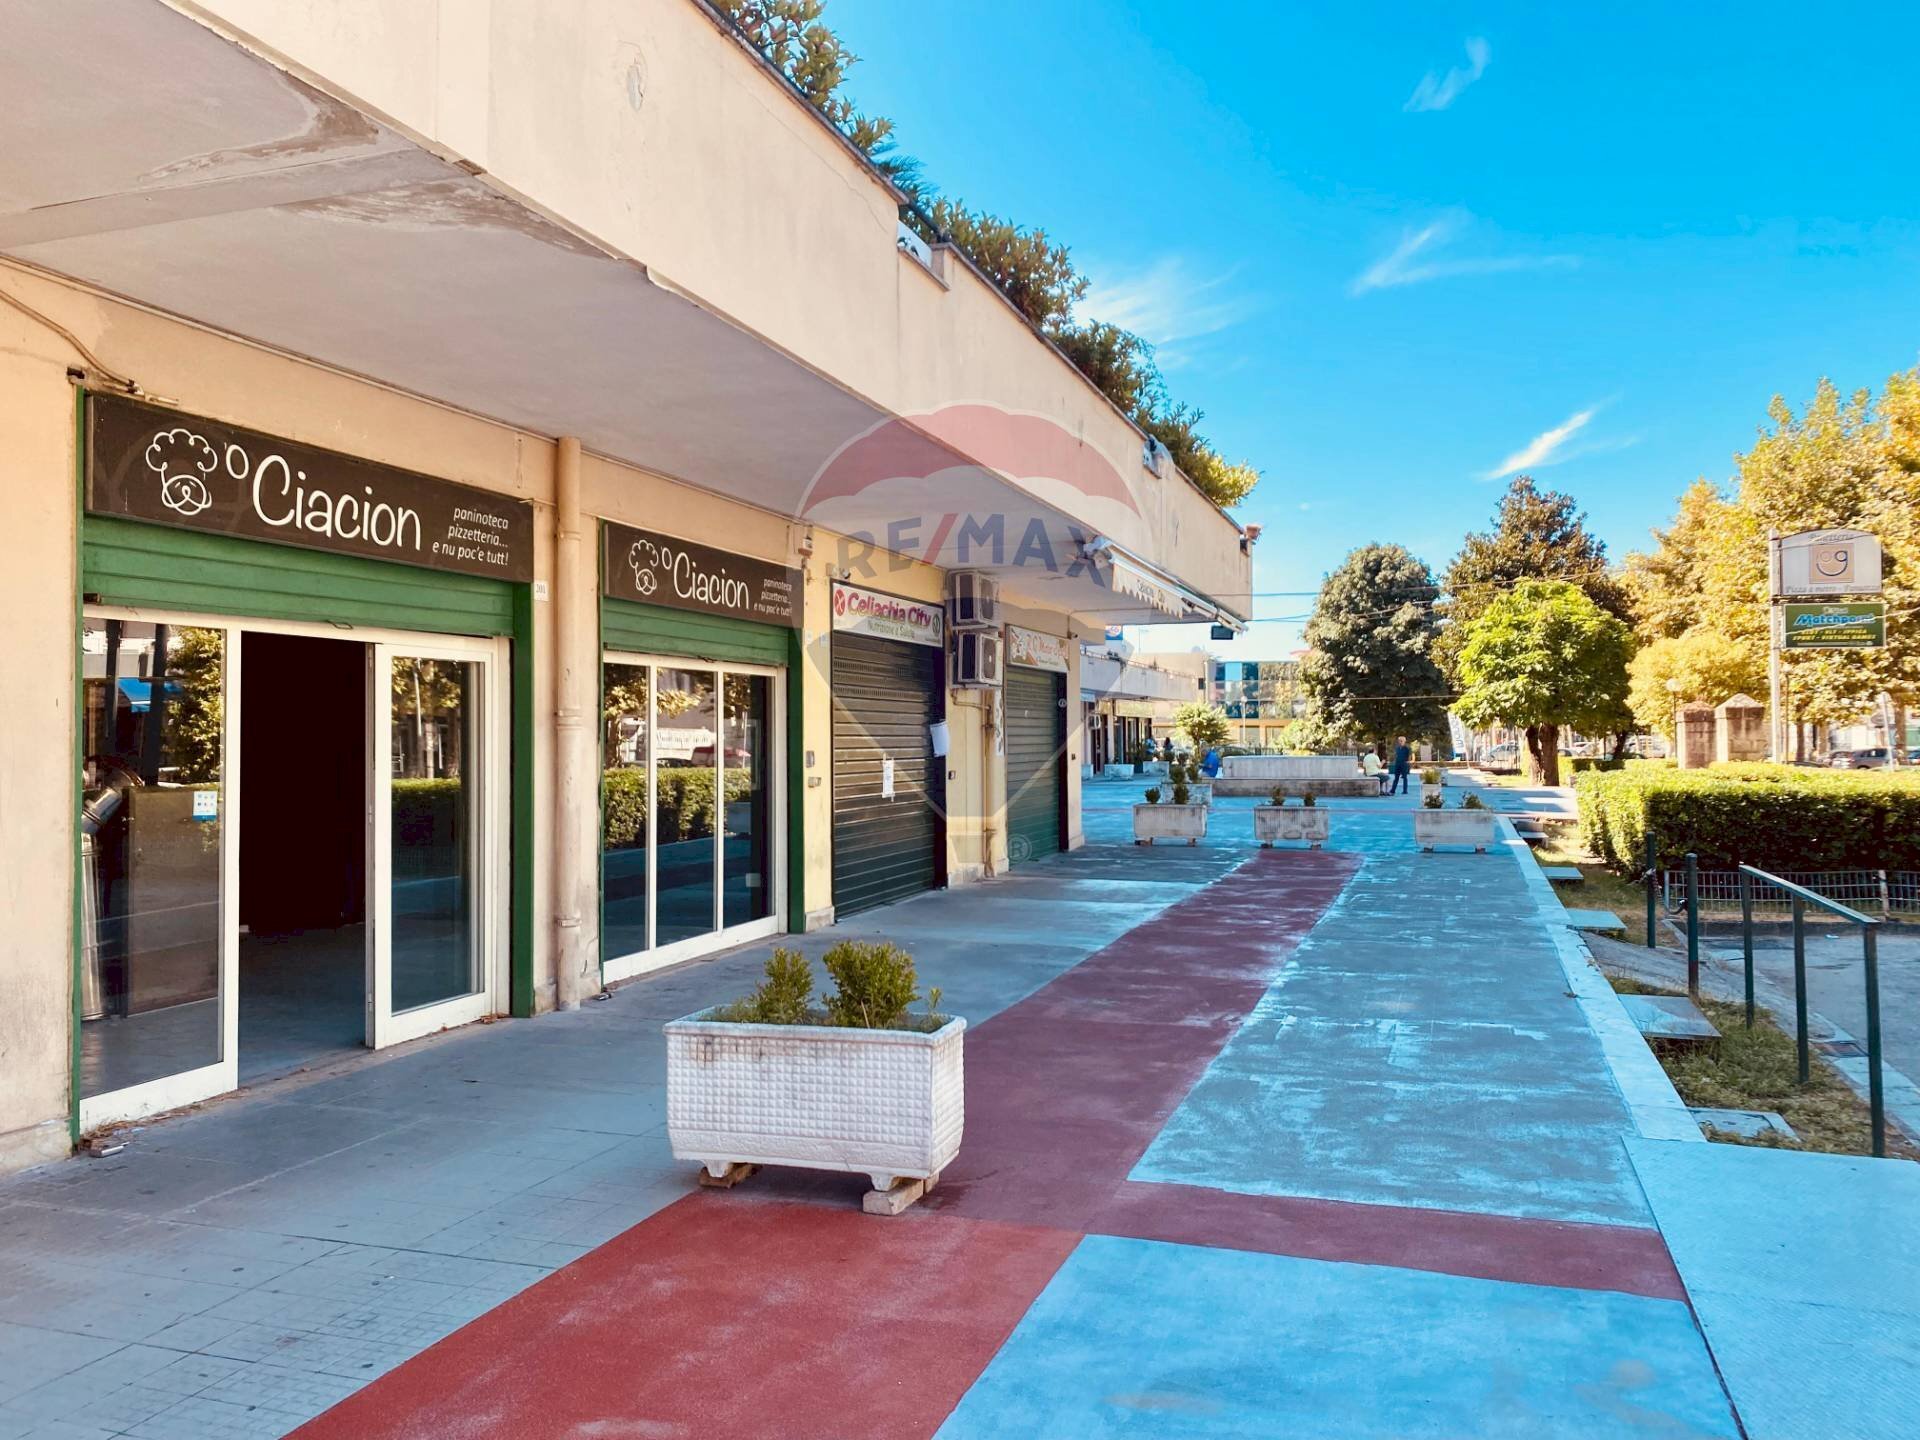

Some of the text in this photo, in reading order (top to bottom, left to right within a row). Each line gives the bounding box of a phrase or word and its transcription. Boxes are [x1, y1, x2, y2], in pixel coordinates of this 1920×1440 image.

[252, 454, 422, 551] Ciacion
[453, 507, 509, 530] paninoteca
[447, 524, 509, 548] pizzetteria...
[432, 541, 509, 566] e nu poc'e tutt!
[673, 552, 750, 610] Ciacion
[847, 592, 932, 628] Celiachia City
[1793, 613, 1876, 627] Matchpo
